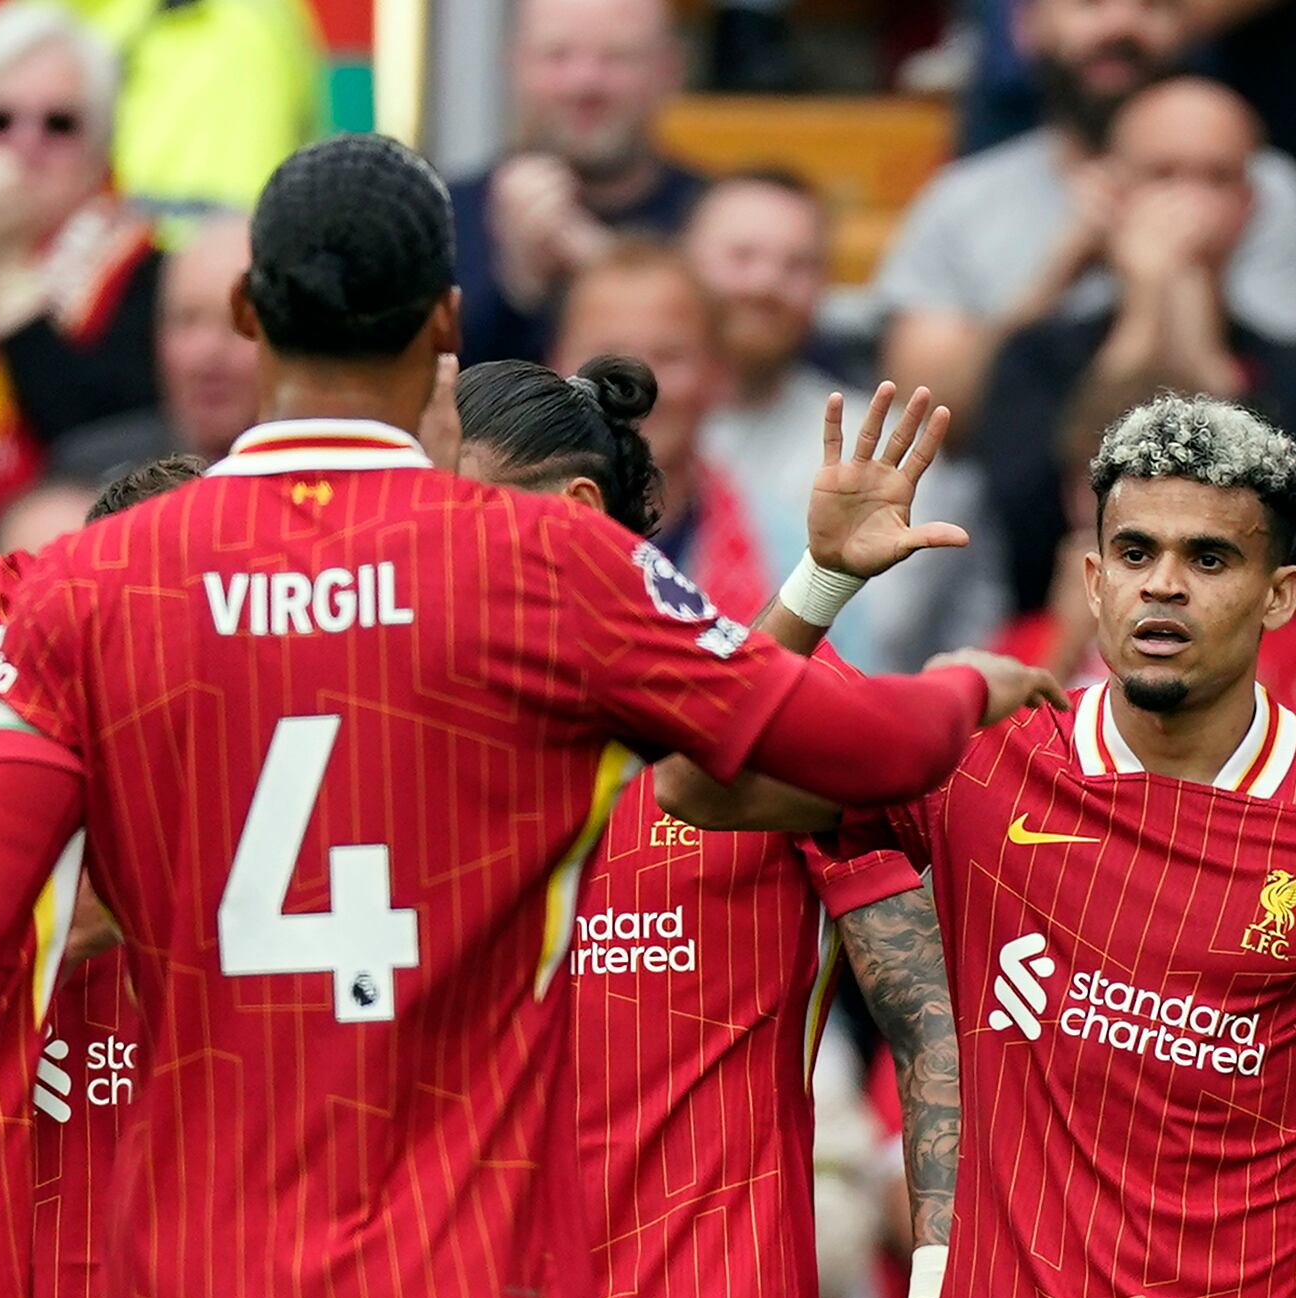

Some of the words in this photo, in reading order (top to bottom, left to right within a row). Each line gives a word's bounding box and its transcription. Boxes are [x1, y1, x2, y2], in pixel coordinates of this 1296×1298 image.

[202, 561, 415, 636] VIRGIL
[218, 714, 420, 1023] 4
[1060, 1005, 1266, 1077] chartered
[1068, 969, 1260, 1047] standard
